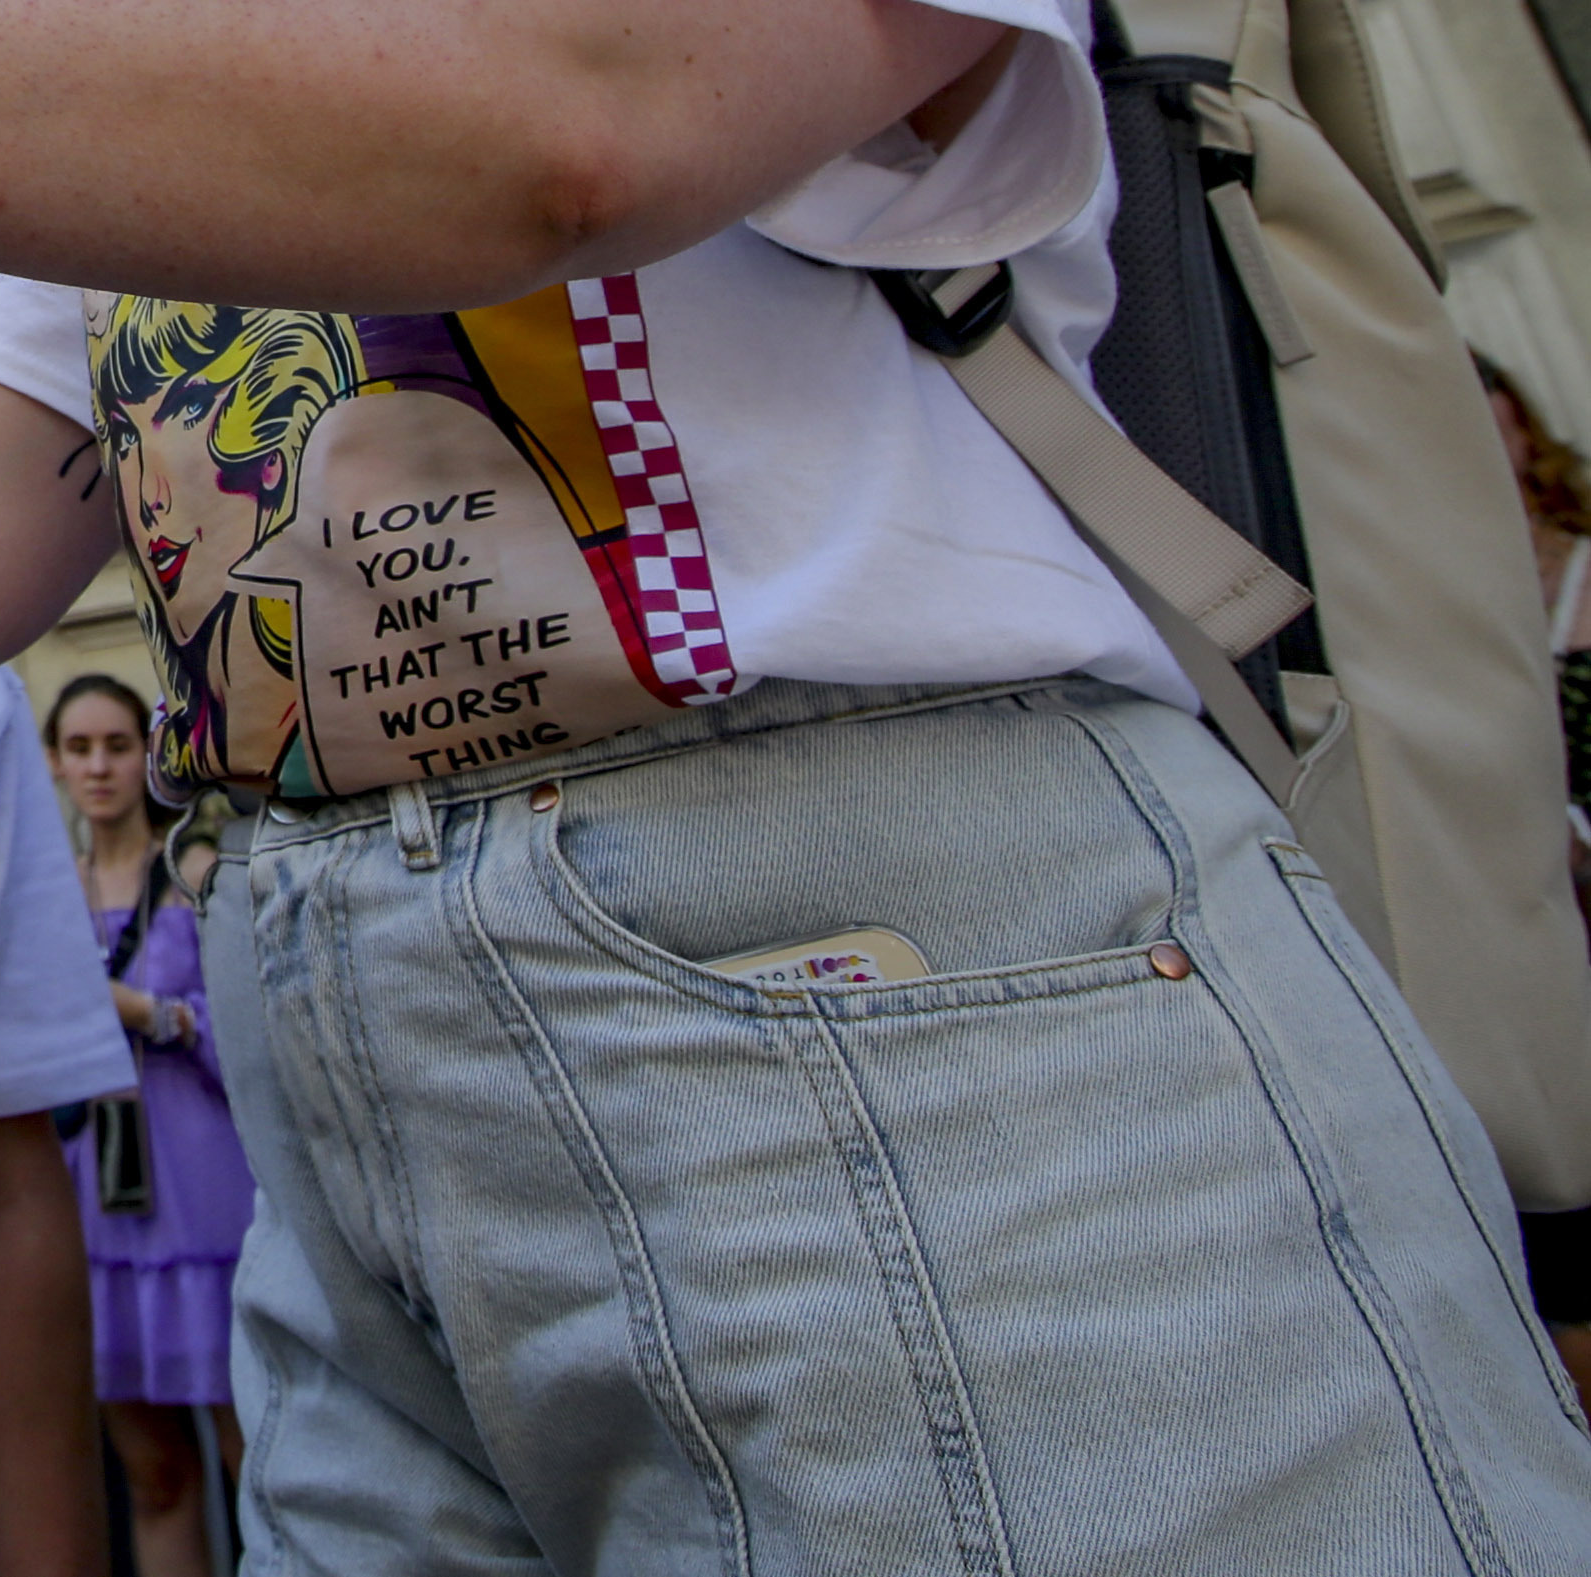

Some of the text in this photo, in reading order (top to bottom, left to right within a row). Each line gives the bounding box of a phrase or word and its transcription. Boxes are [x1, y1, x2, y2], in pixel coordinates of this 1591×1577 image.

[322, 489, 497, 548] I LOVE
[374, 577, 493, 639] AIN'T
[329, 612, 571, 699] THAT THE
[379, 670, 548, 740] WORST
[408, 721, 570, 777] THING
